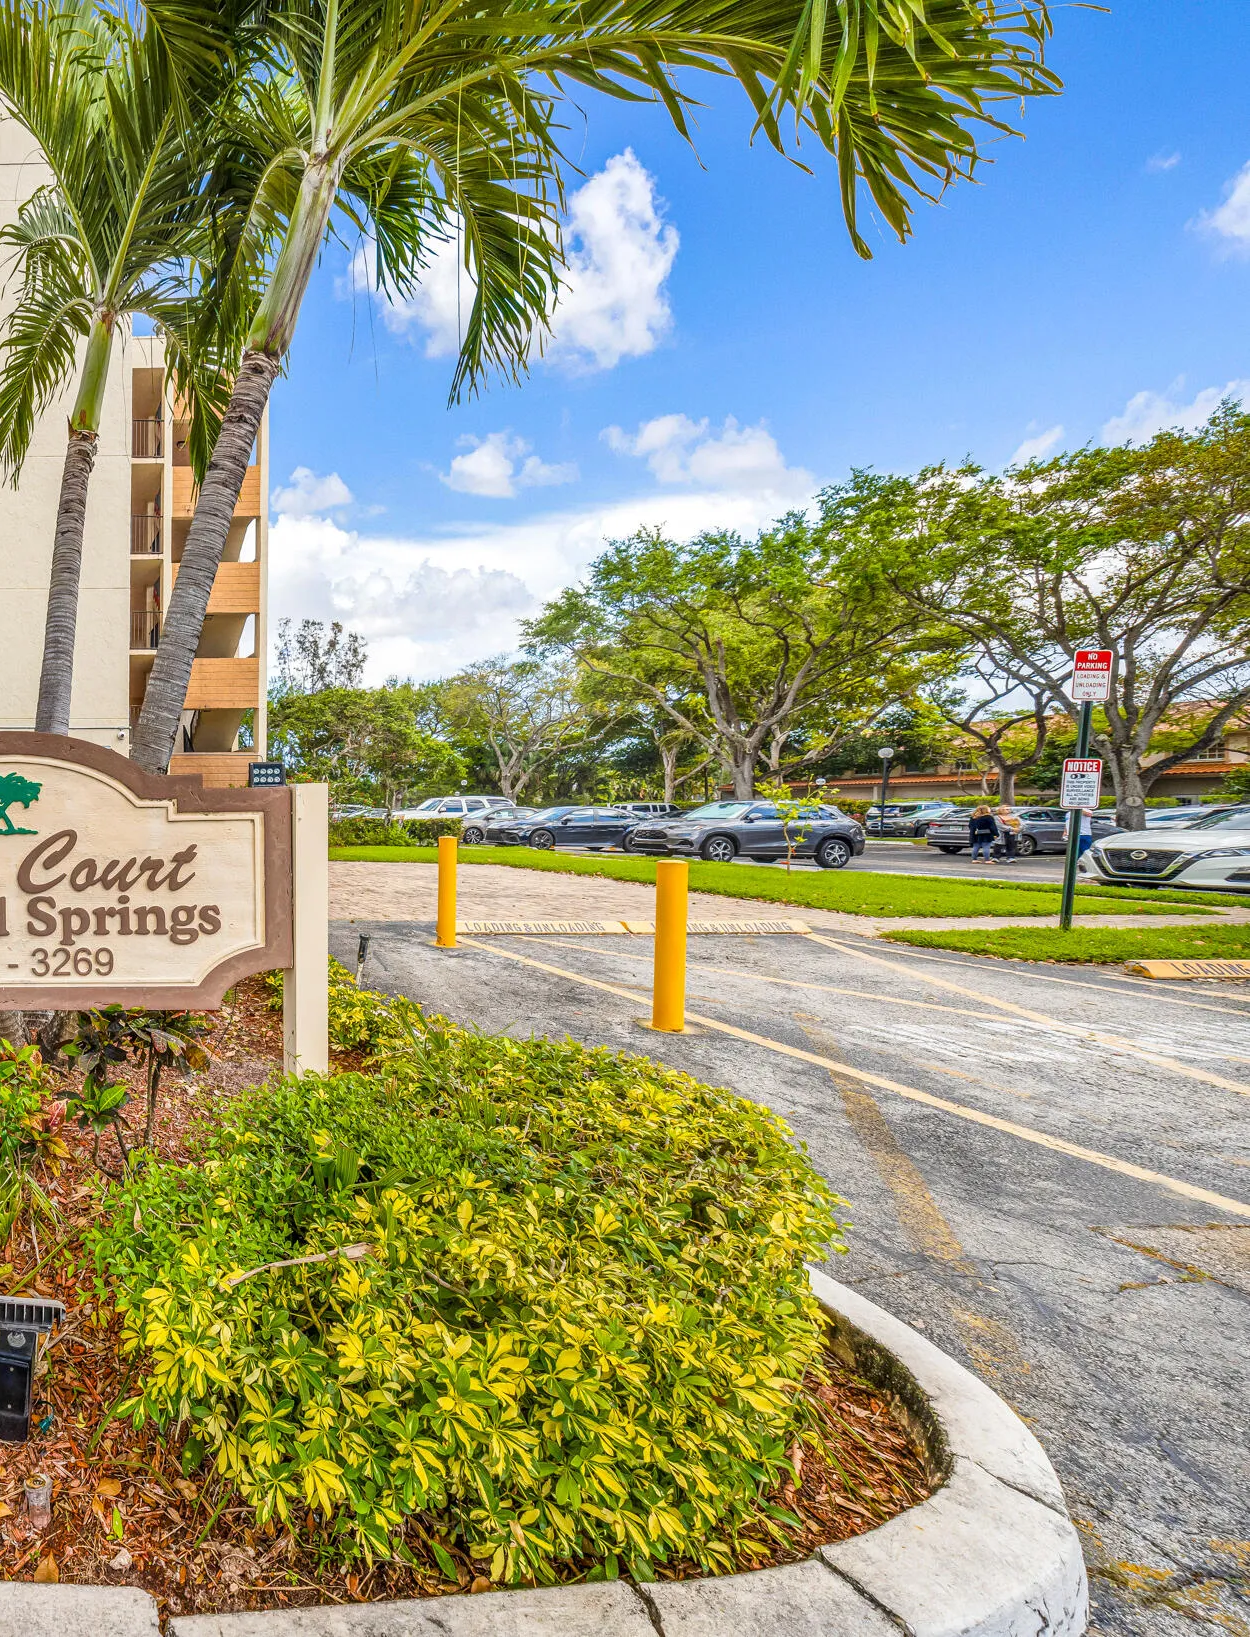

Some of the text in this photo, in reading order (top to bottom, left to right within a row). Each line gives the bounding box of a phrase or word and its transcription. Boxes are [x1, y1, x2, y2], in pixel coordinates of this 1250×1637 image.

[1077, 662, 1108, 670] PARKING
[1067, 761, 1098, 772] NOTICE
[17, 829, 199, 894] Court
[27, 895, 222, 946] Springs
[31, 947, 114, 977] 3269
